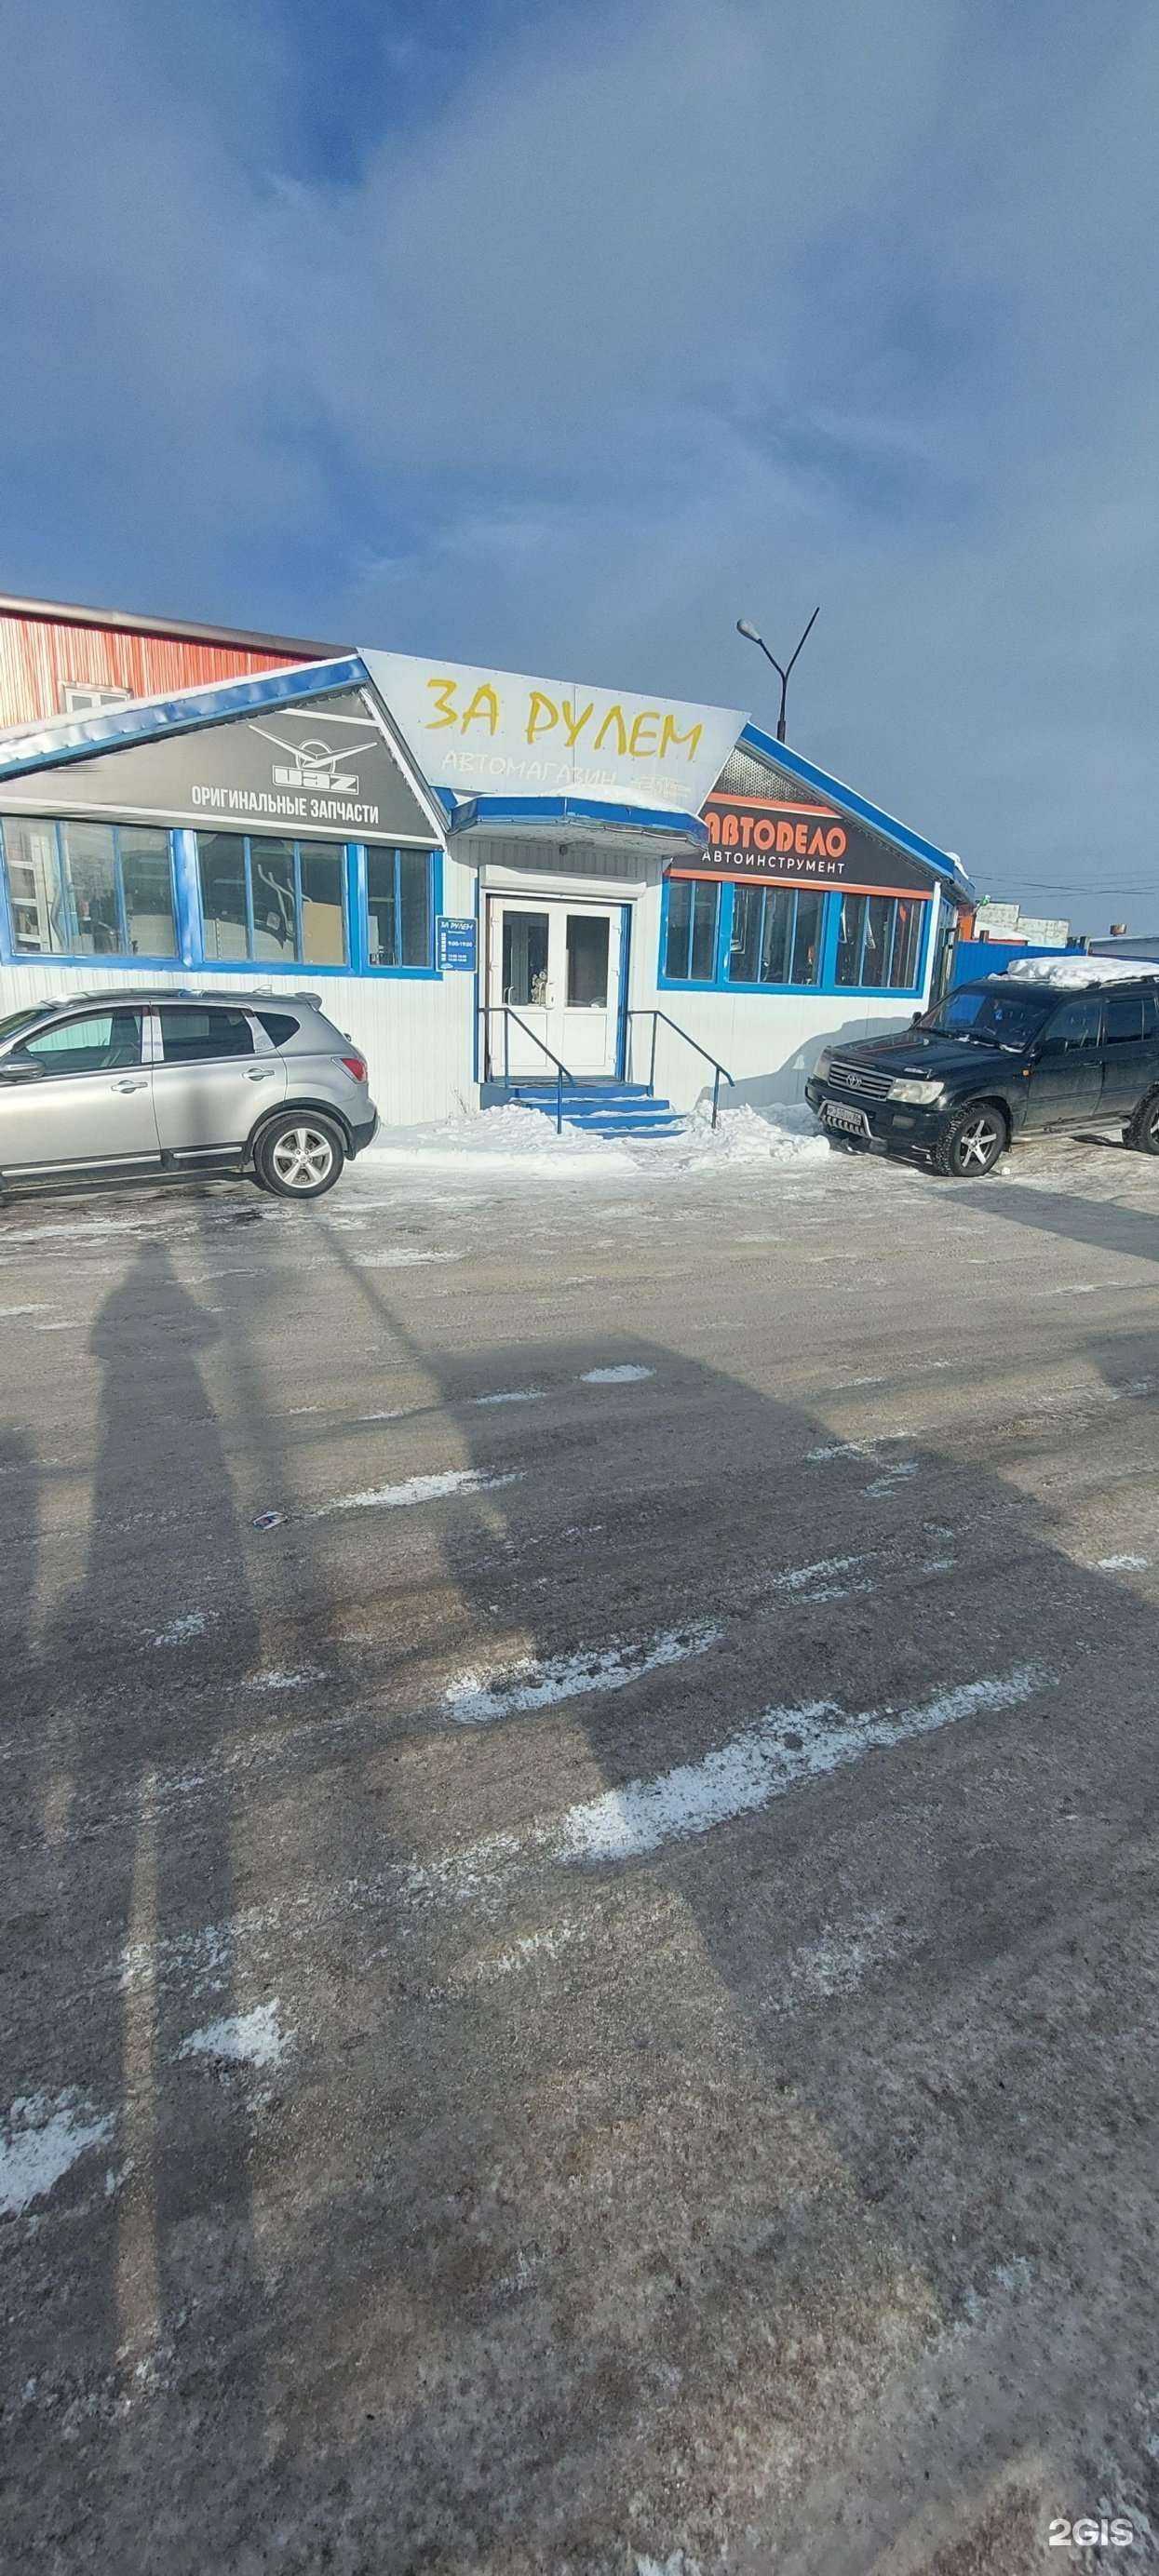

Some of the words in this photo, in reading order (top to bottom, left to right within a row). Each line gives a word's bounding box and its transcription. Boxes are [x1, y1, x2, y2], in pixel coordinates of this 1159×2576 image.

[425, 678, 500, 736] ЗА
[526, 691, 705, 761] РУЛЕМ
[441, 750, 616, 785] АВТОМАГАЗИН
[192, 785, 307, 817] ОРИГИНАЛЬНЫЕ
[310, 798, 379, 824] ЗАПЧАСТИ
[702, 851, 845, 875] АВТОИНСТРУМЕНТ
